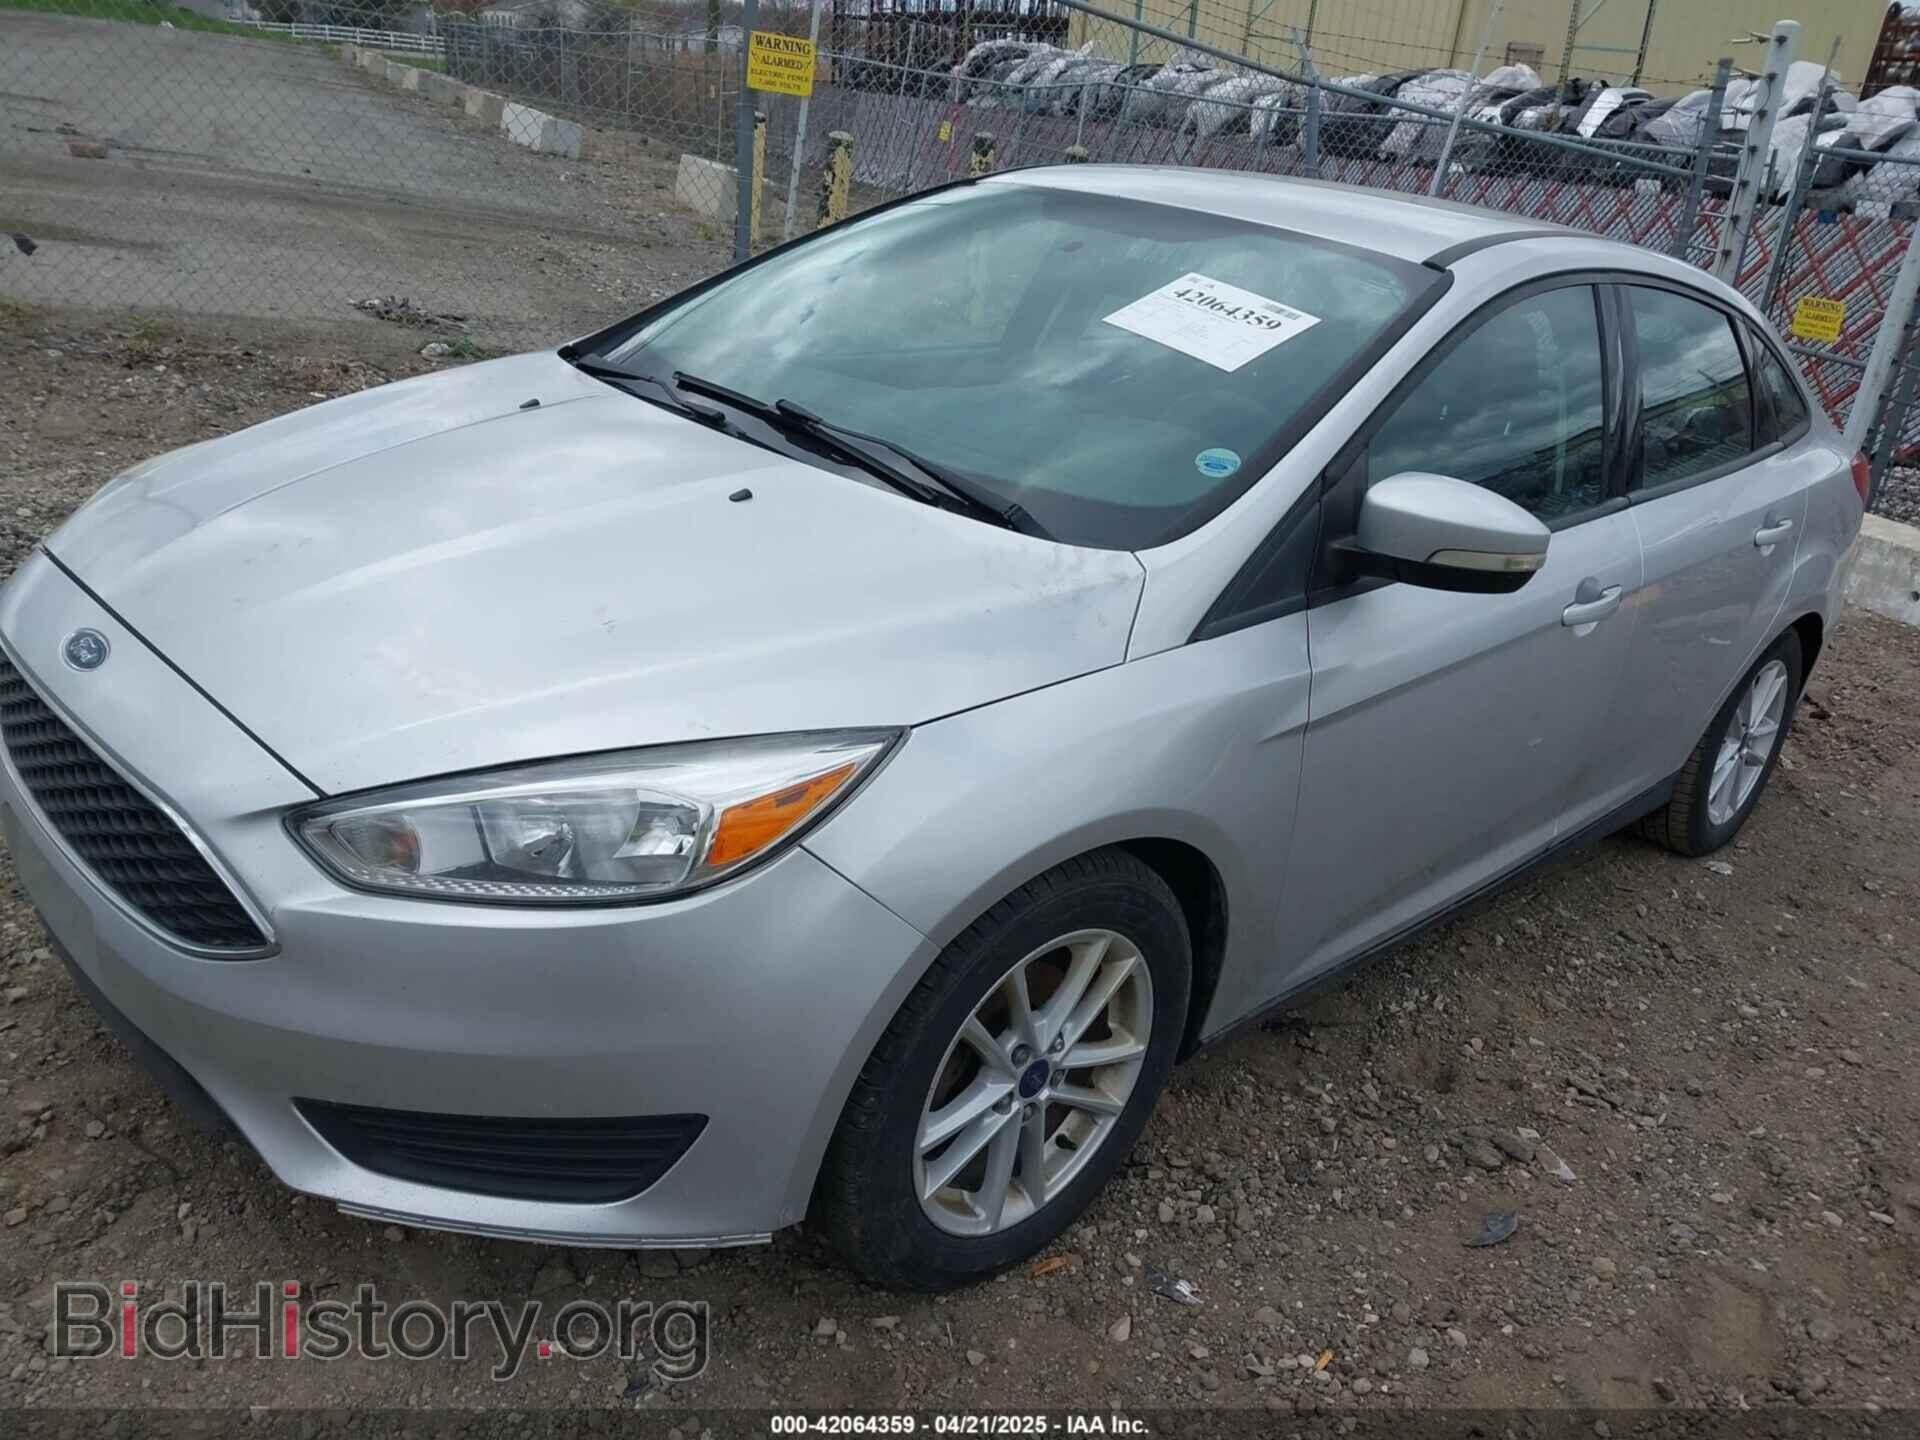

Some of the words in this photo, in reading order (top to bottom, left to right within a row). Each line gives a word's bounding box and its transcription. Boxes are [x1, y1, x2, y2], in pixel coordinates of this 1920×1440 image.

[755, 34, 810, 54] WARNING
[762, 55, 802, 70] ALARMED
[1173, 287, 1283, 331] 42064359
